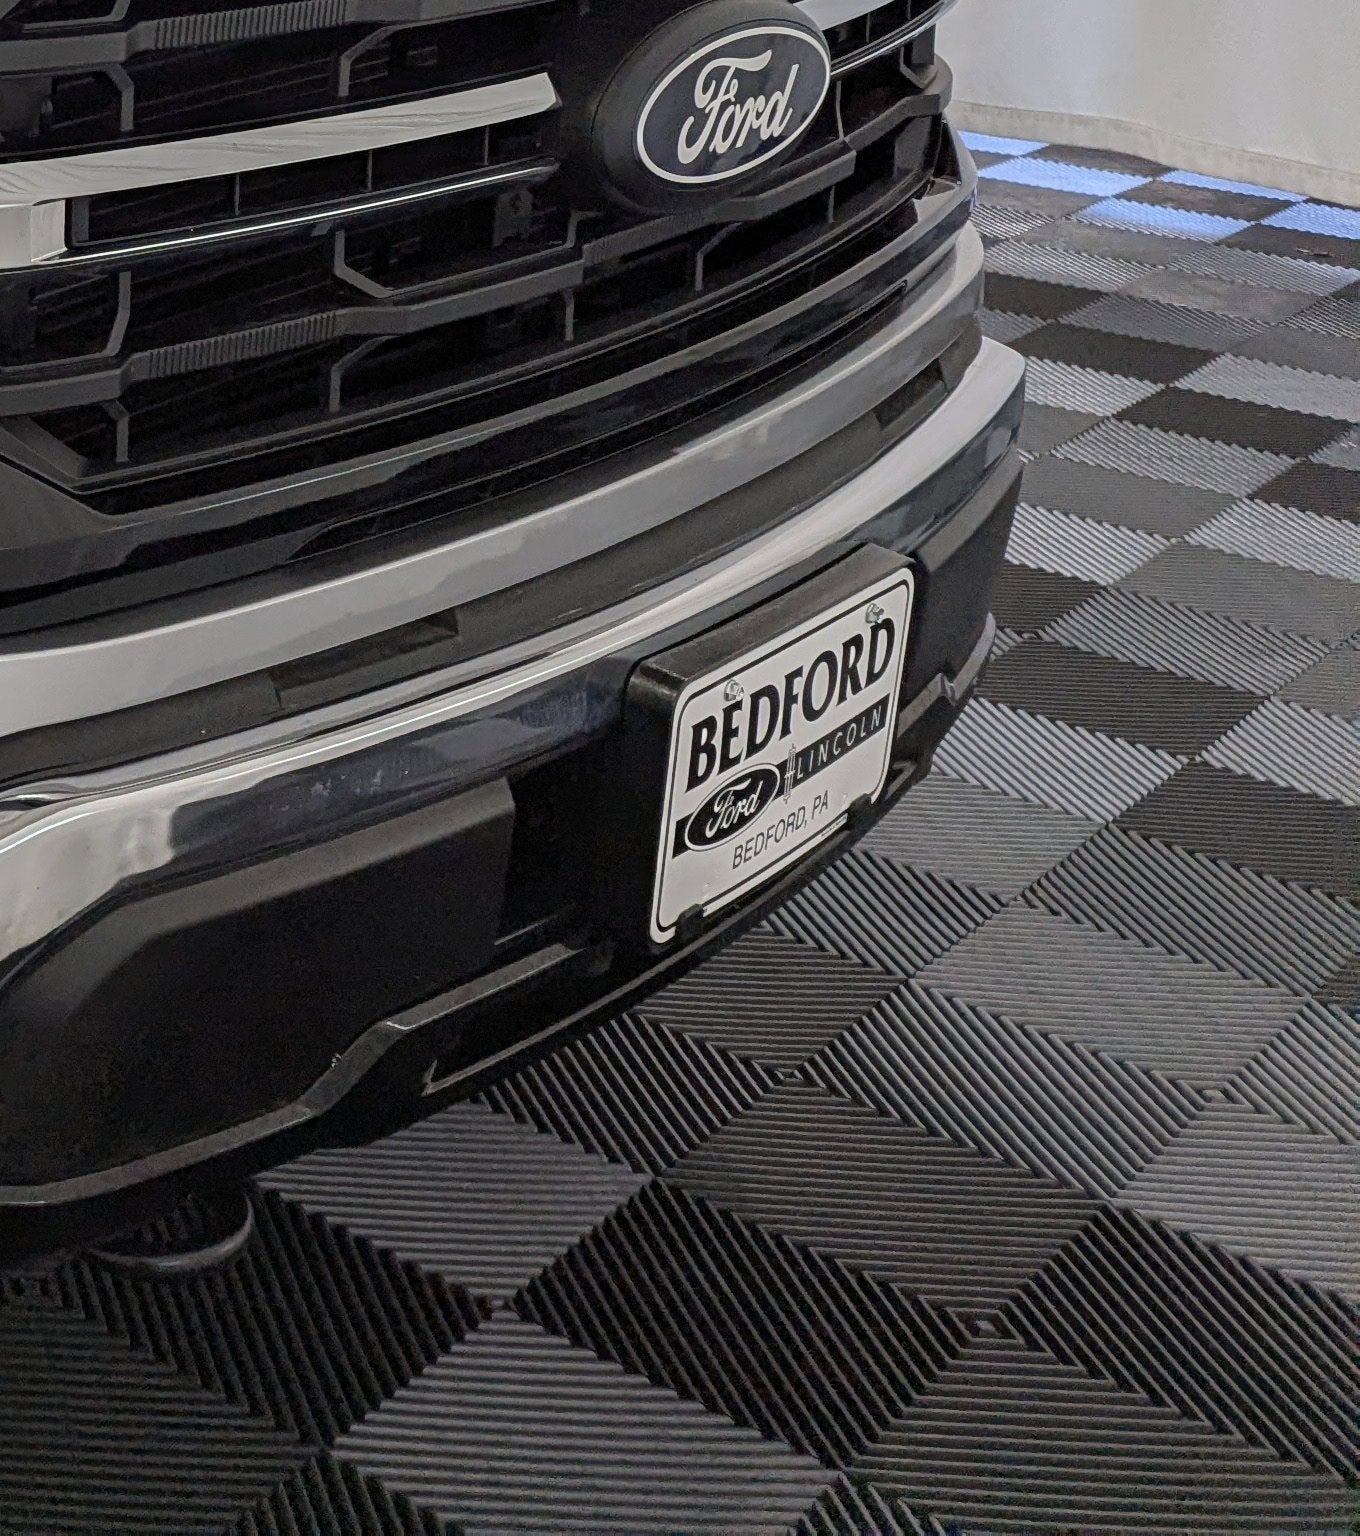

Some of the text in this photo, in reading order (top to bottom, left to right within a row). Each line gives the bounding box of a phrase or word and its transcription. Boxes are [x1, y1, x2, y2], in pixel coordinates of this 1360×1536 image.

[677, 49, 800, 164] Ford
[685, 617, 896, 794] BEDFORD
[705, 707, 883, 839] Ford LINCOLN
[732, 805, 808, 870] BEDFORD,
[811, 790, 829, 820] PA
